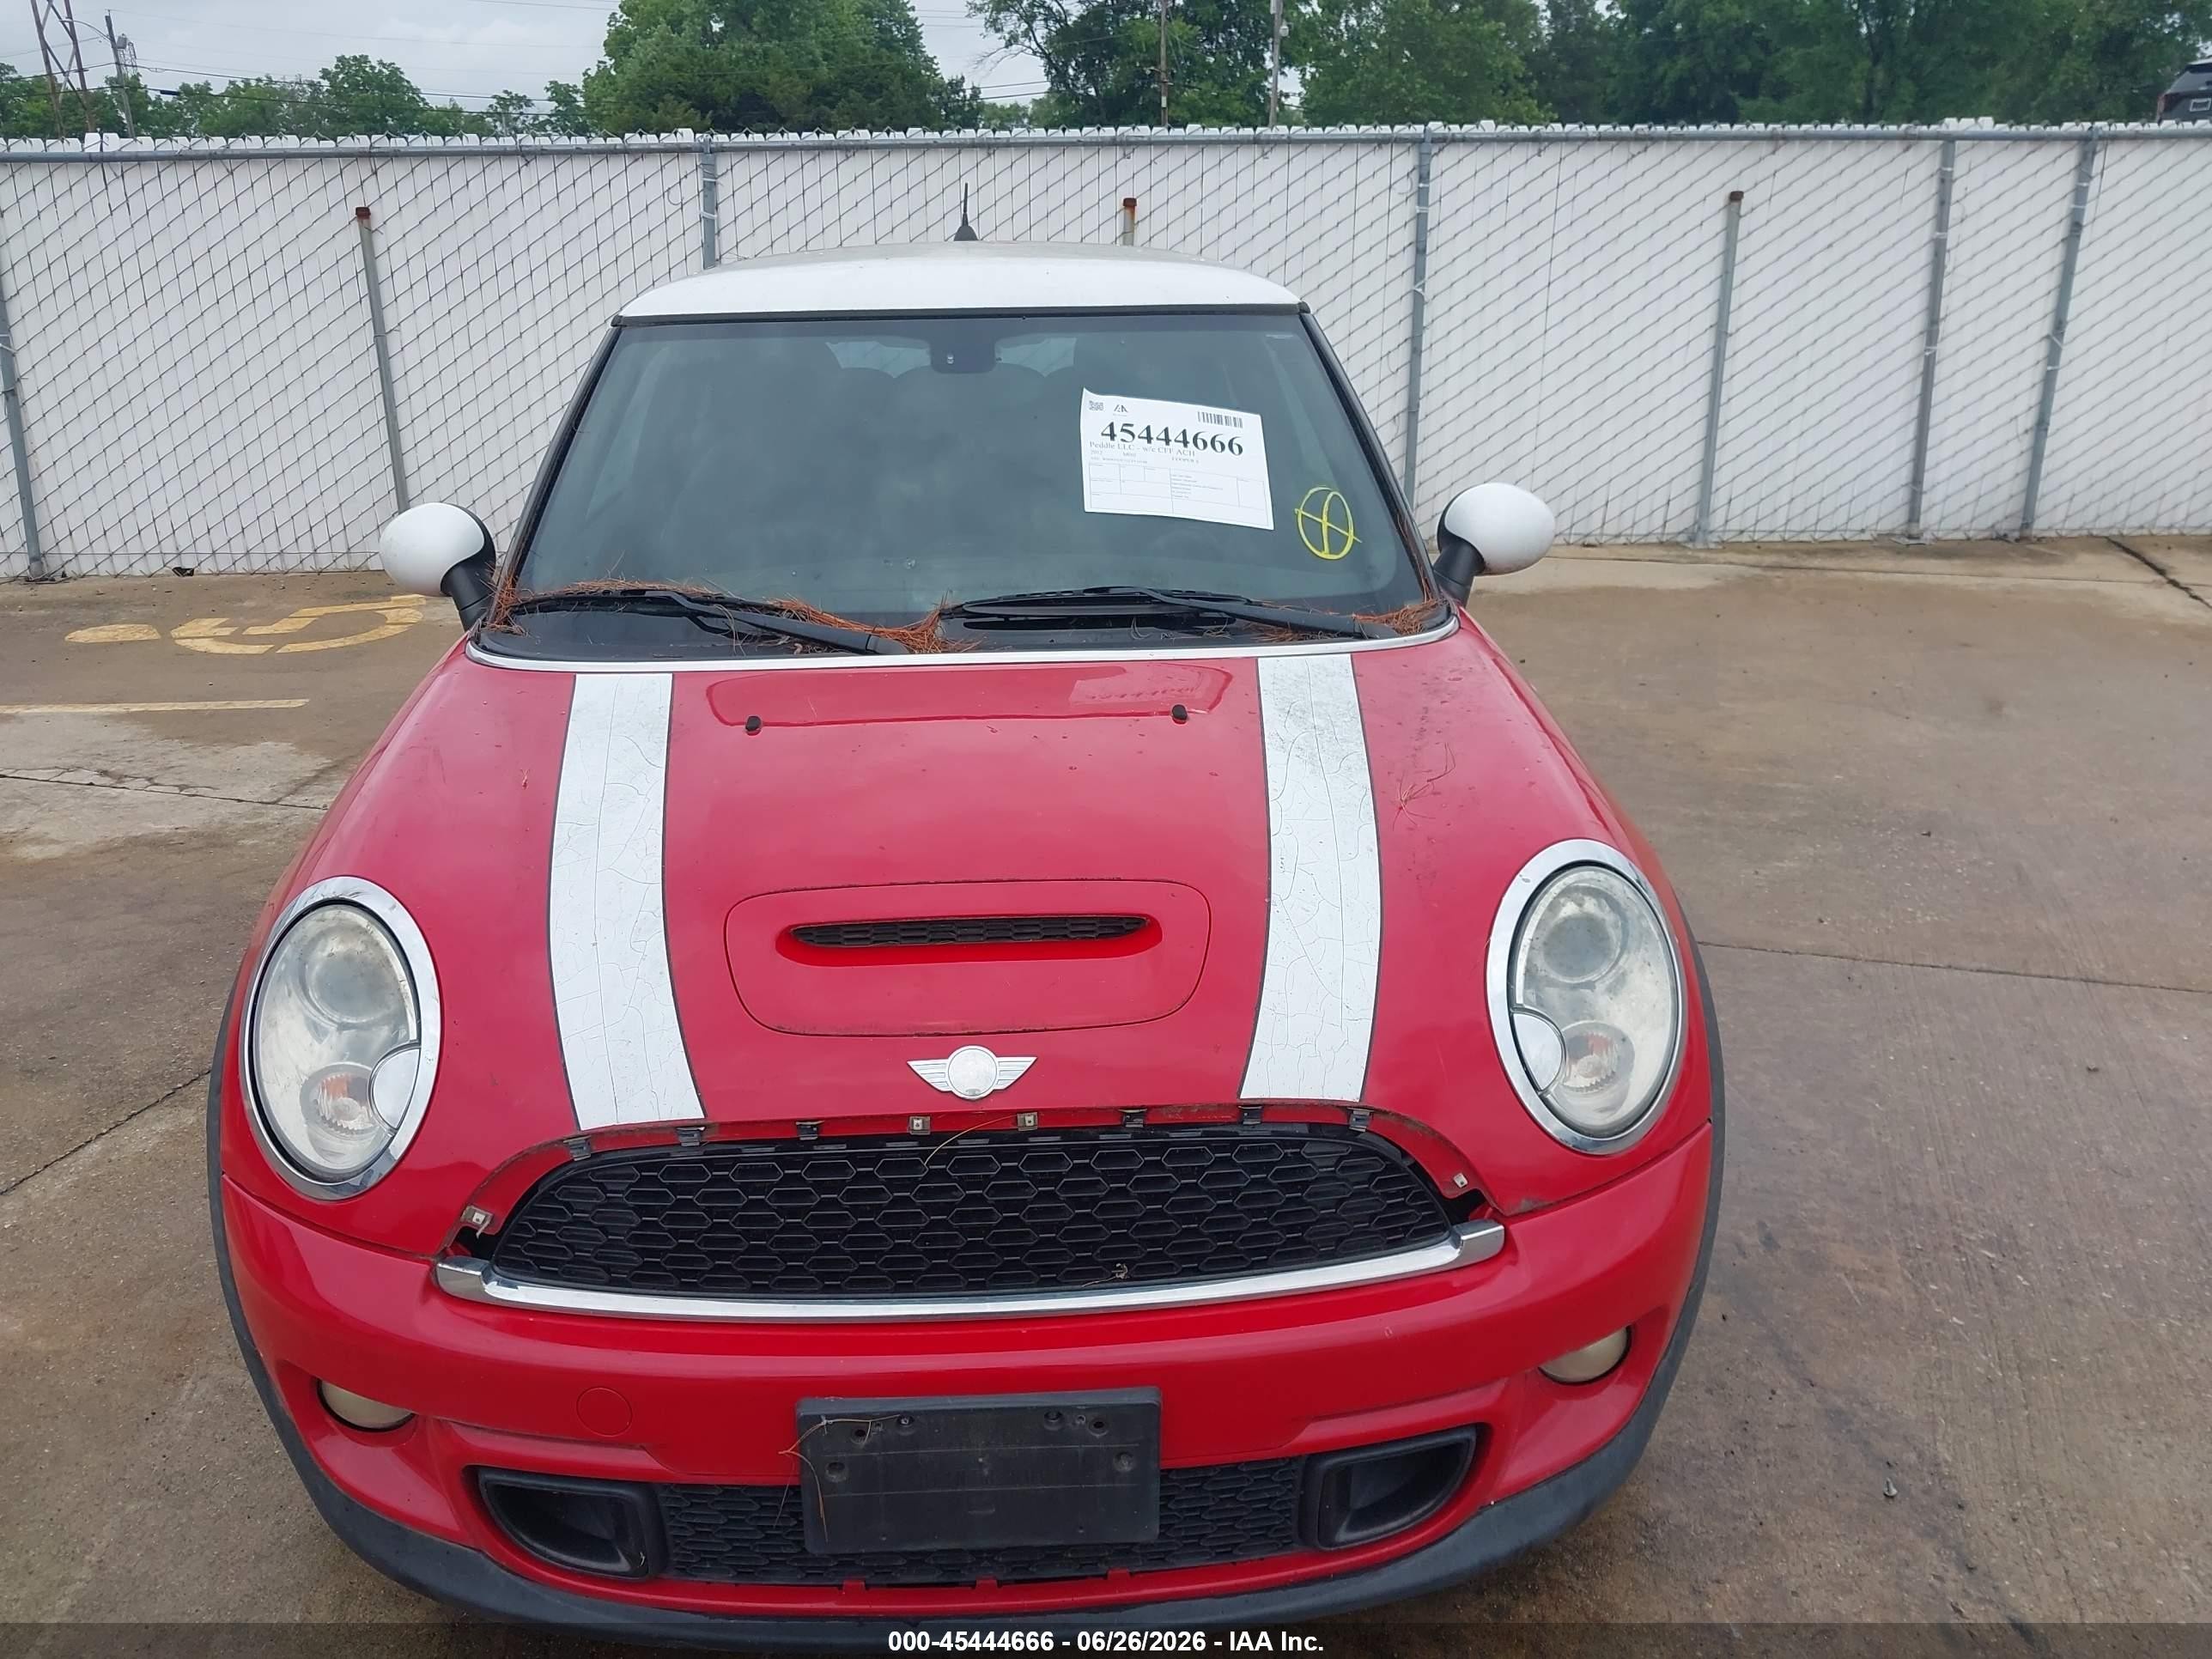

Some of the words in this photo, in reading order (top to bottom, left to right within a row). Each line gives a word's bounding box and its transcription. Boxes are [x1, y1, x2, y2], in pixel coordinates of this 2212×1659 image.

[1090, 441, 1115, 450] Peddle
[1117, 443, 1135, 452] LLC
[1101, 421, 1243, 457] 45444666
